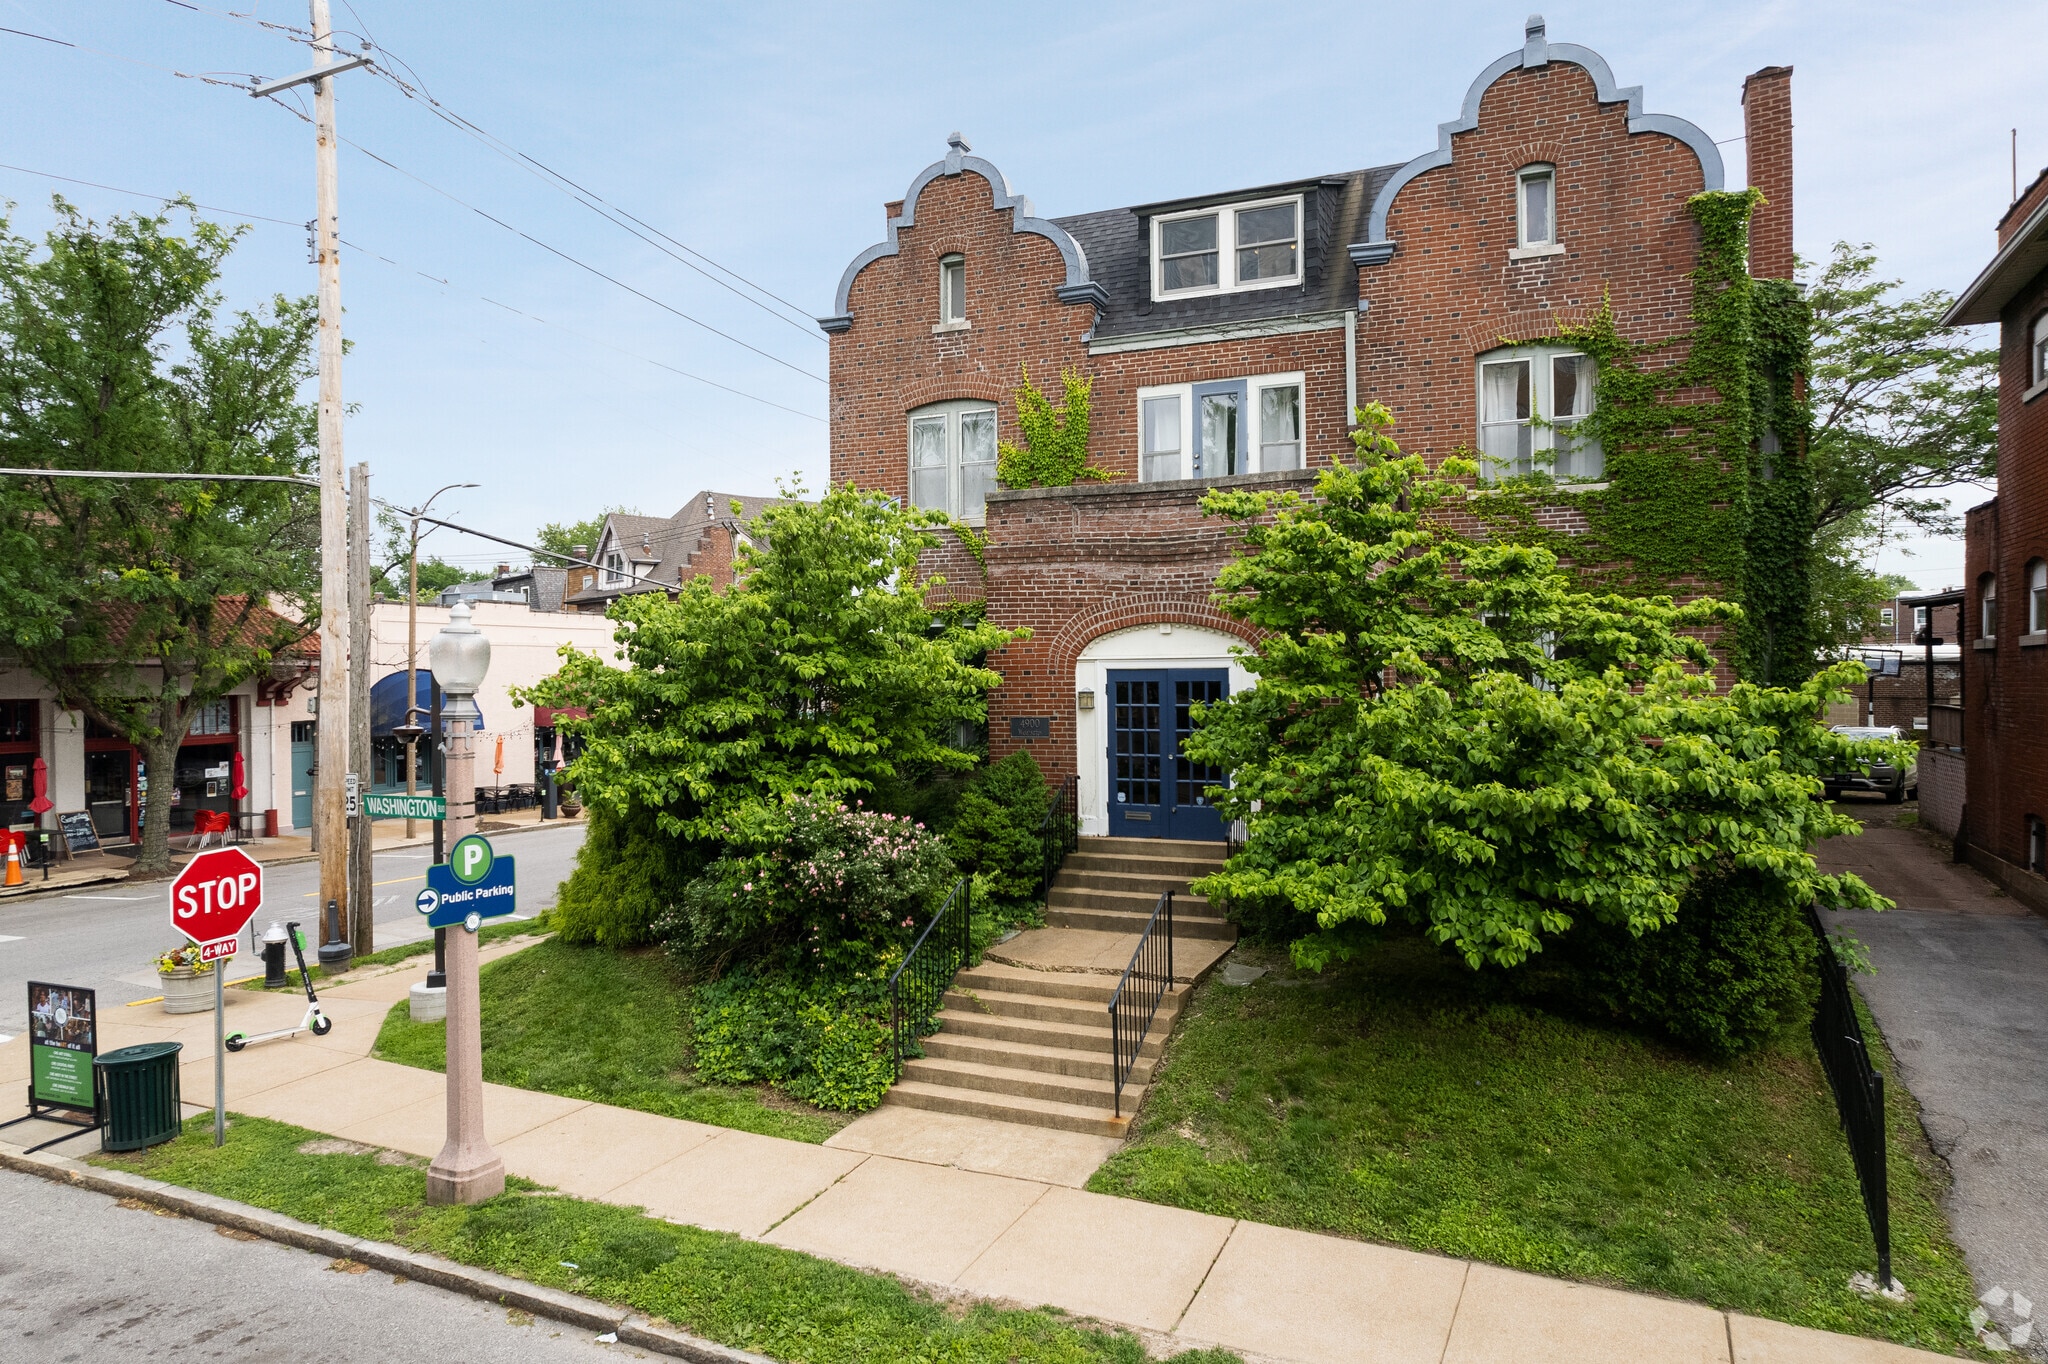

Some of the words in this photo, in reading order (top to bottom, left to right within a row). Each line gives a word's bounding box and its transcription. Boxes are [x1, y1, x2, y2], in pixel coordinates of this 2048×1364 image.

[1020, 718, 1040, 728] 4900
[366, 797, 437, 817] WASHINGTON
[464, 844, 483, 876] P
[177, 872, 257, 919] STOP
[441, 890, 473, 905] Public
[475, 884, 514, 899] Parking
[203, 941, 236, 958] 4-WAY
